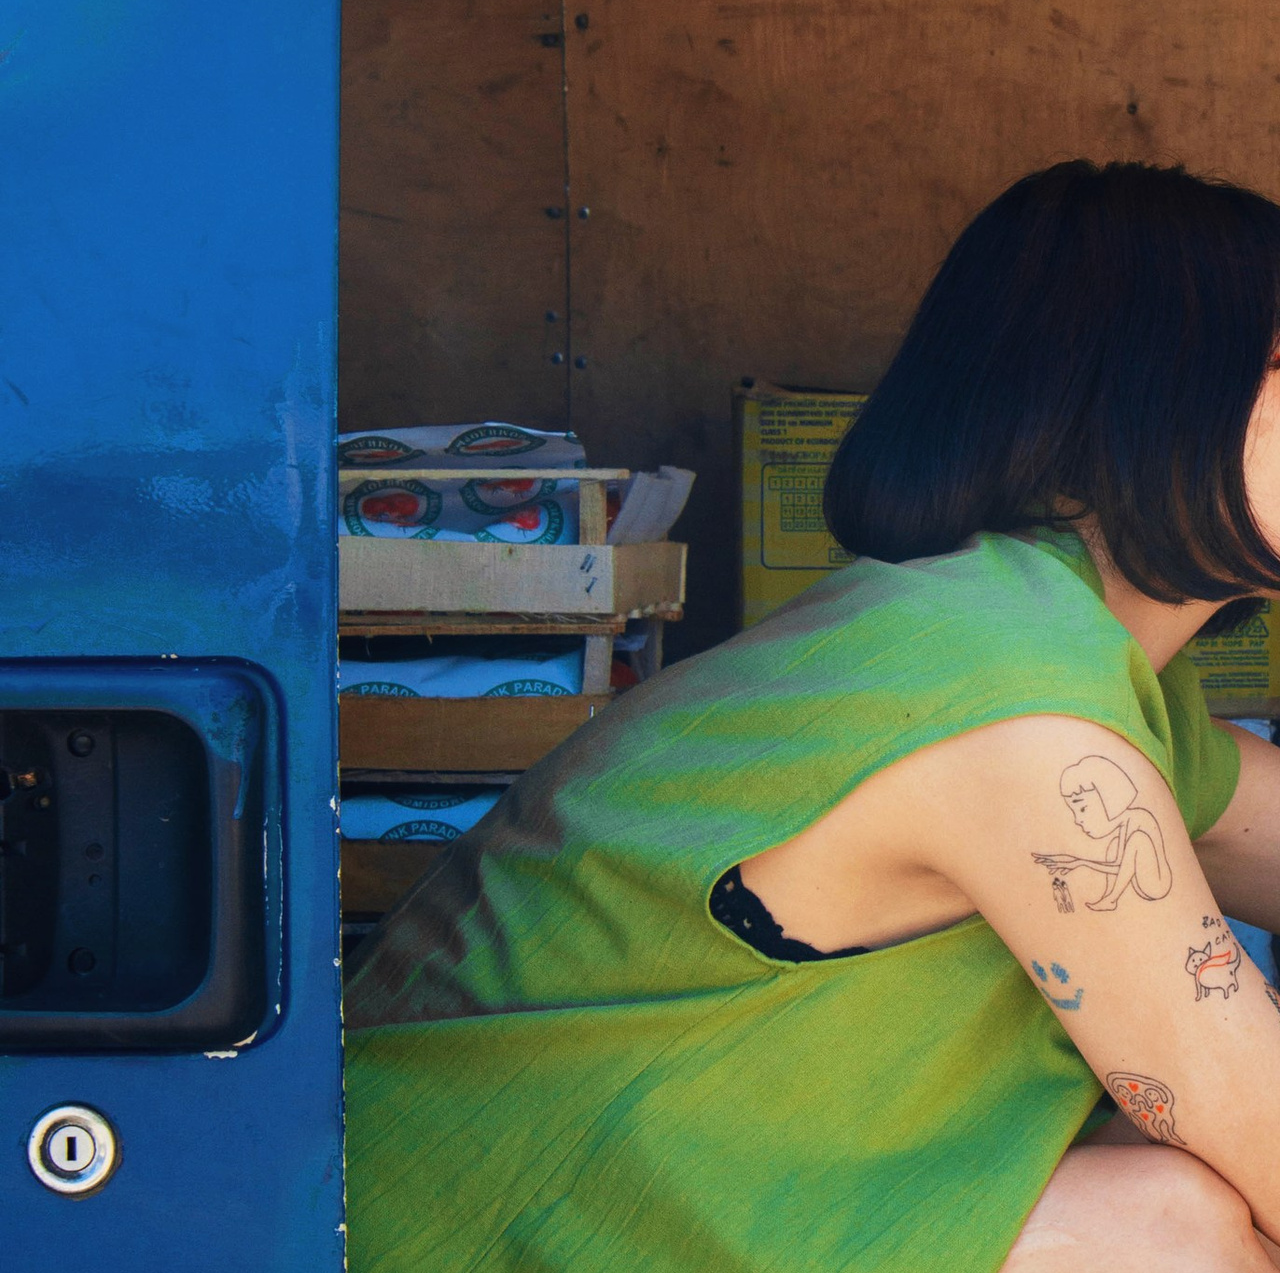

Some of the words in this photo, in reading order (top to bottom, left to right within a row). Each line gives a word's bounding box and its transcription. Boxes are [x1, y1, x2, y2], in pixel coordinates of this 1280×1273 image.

[361, 683, 418, 697] PARAD
[514, 682, 568, 696] PARAD
[1202, 916, 1221, 928] BAD
[1215, 930, 1231, 945] CAT
